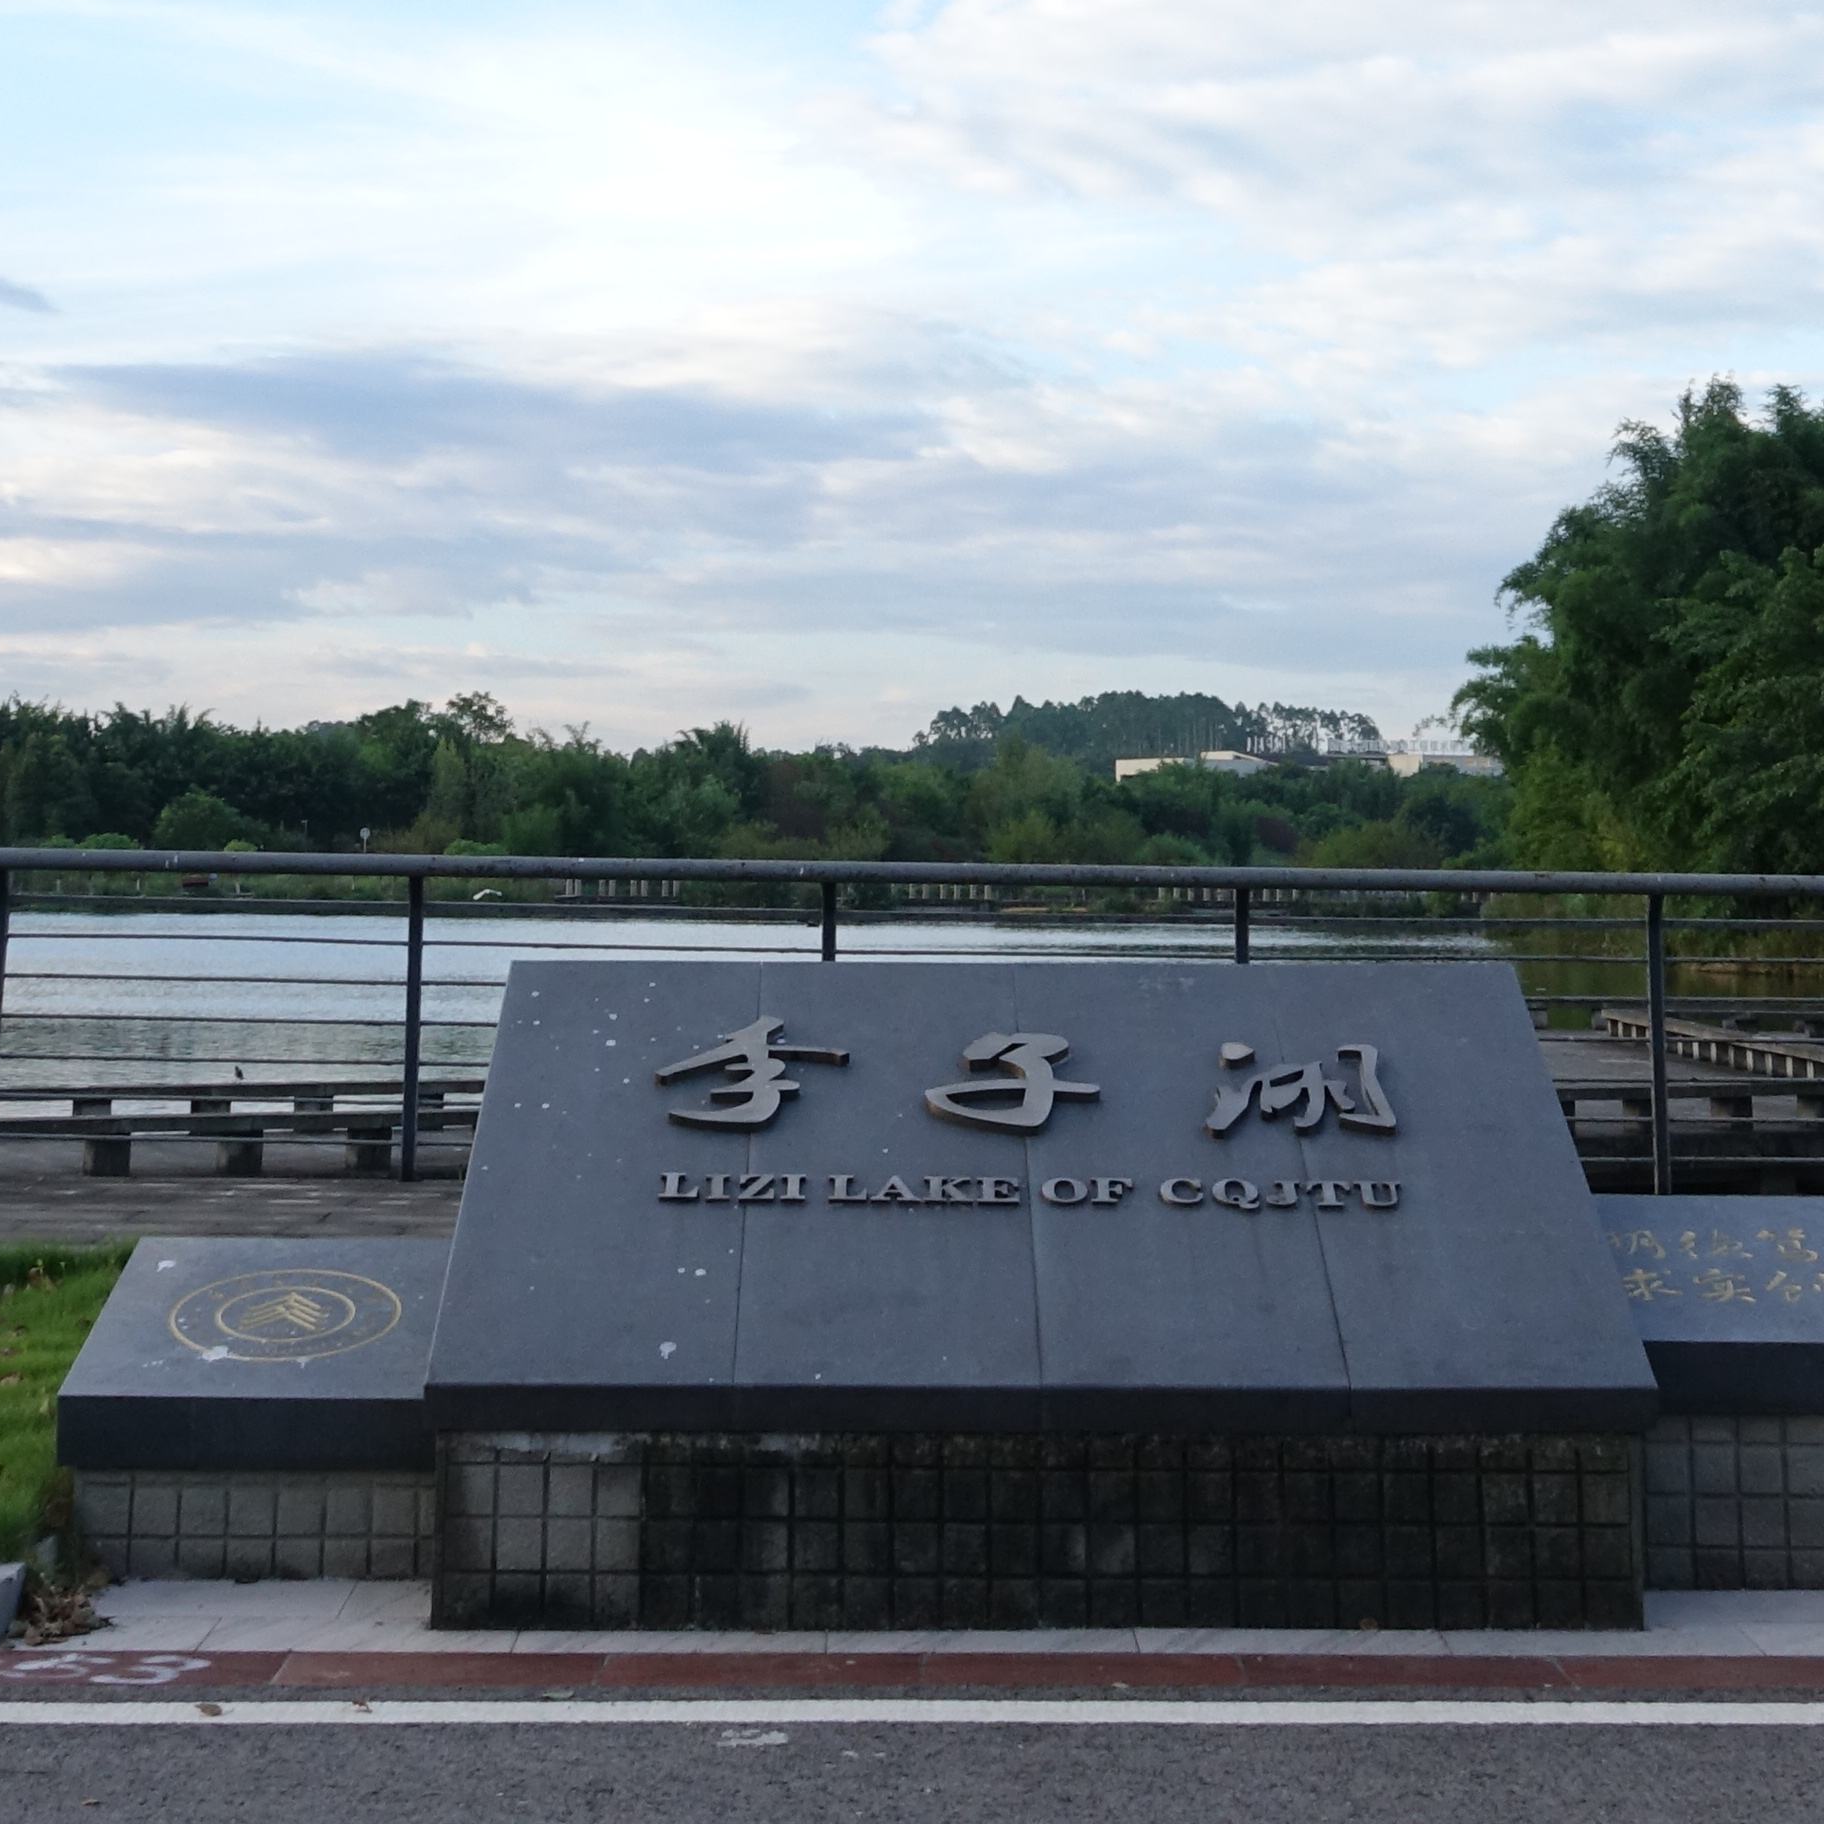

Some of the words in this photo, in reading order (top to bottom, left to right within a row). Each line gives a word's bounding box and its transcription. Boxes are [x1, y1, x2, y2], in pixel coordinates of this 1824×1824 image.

[655, 1014, 1397, 1138] 李子湖
[657, 1171, 807, 1205] LIZI
[828, 1174, 1021, 1206] LAKE
[1040, 1175, 1134, 1207] OF
[1158, 1177, 1402, 1210] CQJTU
